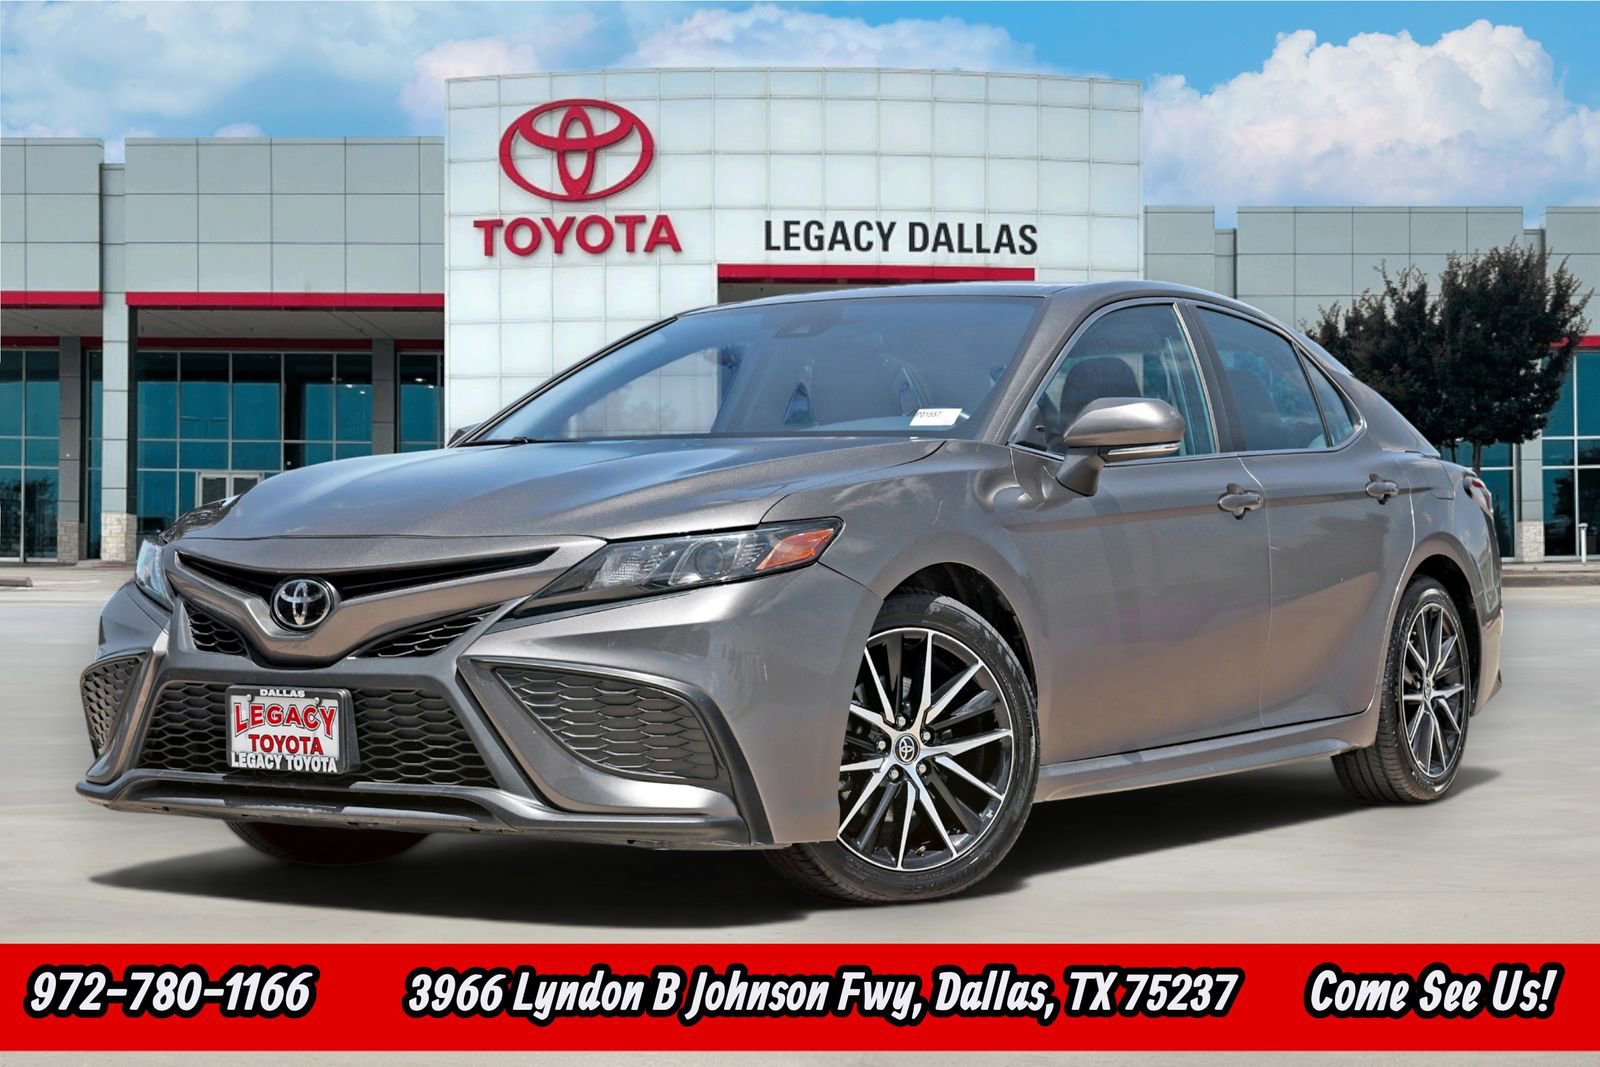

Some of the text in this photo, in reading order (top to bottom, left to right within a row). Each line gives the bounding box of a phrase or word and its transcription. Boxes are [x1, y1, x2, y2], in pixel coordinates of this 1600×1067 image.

[474, 214, 682, 256] TOYOTA
[765, 221, 1038, 255] LEGACY DALLAS
[259, 689, 306, 698] DALLAS
[234, 703, 338, 739] LEGACY
[248, 734, 325, 755] TOYOTA
[231, 752, 338, 773] LEGACY TOYOTA
